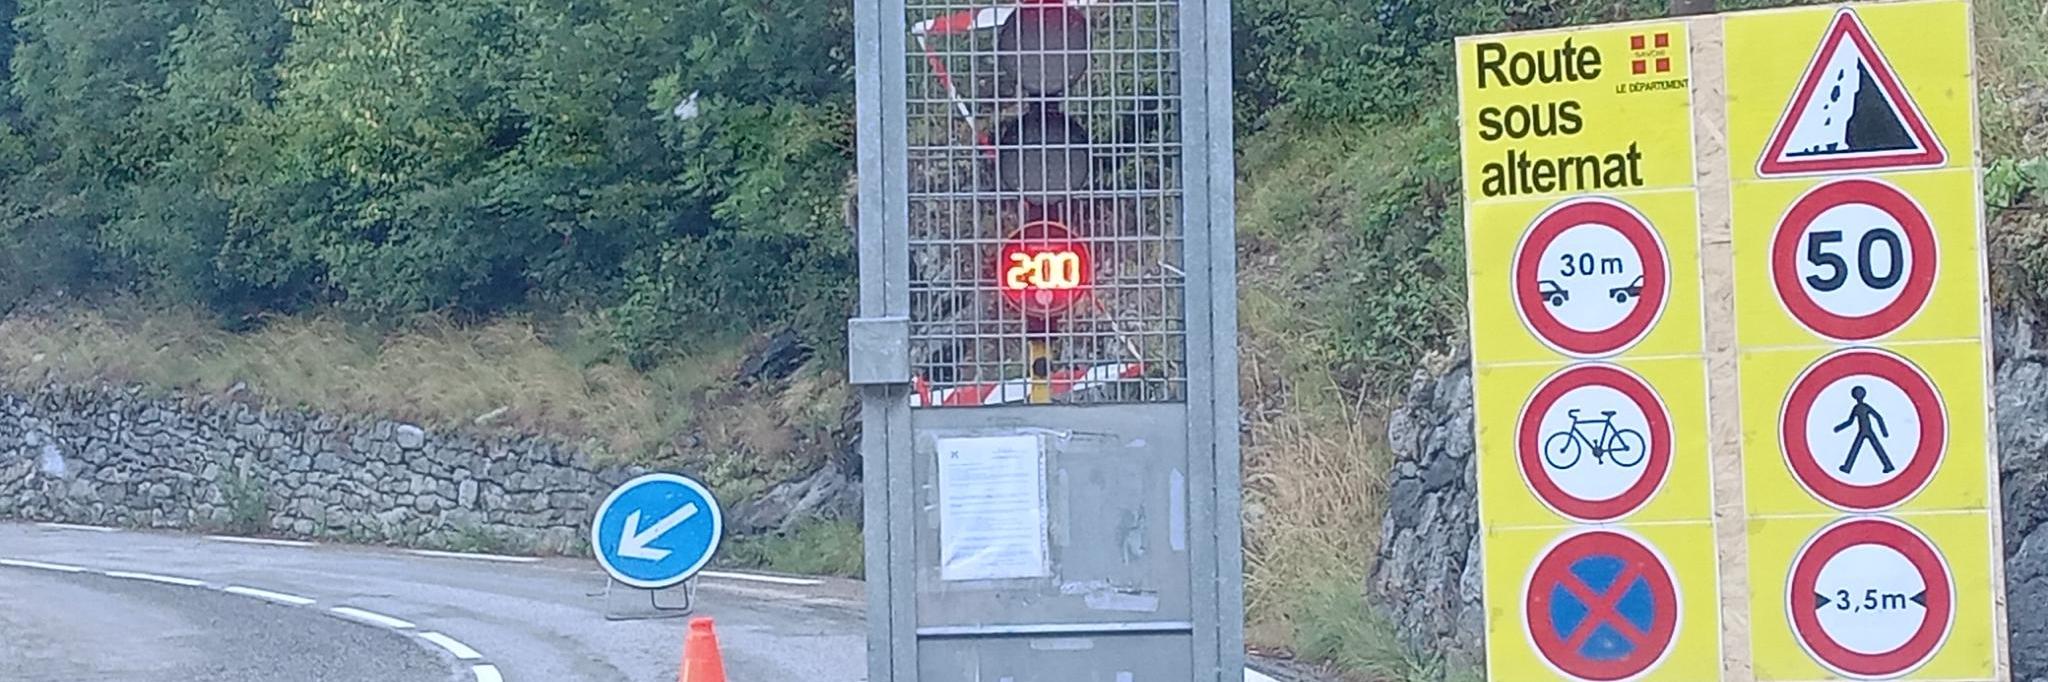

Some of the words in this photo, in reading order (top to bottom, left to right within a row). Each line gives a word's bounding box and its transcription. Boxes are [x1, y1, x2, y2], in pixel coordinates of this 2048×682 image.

[1476, 37, 1602, 89] Route
[1616, 83, 1627, 94] LE
[1478, 100, 1583, 141] sous
[1481, 141, 1643, 197] alternat
[1806, 228, 1904, 292] 50
[1836, 589, 1906, 613] 3,5m
